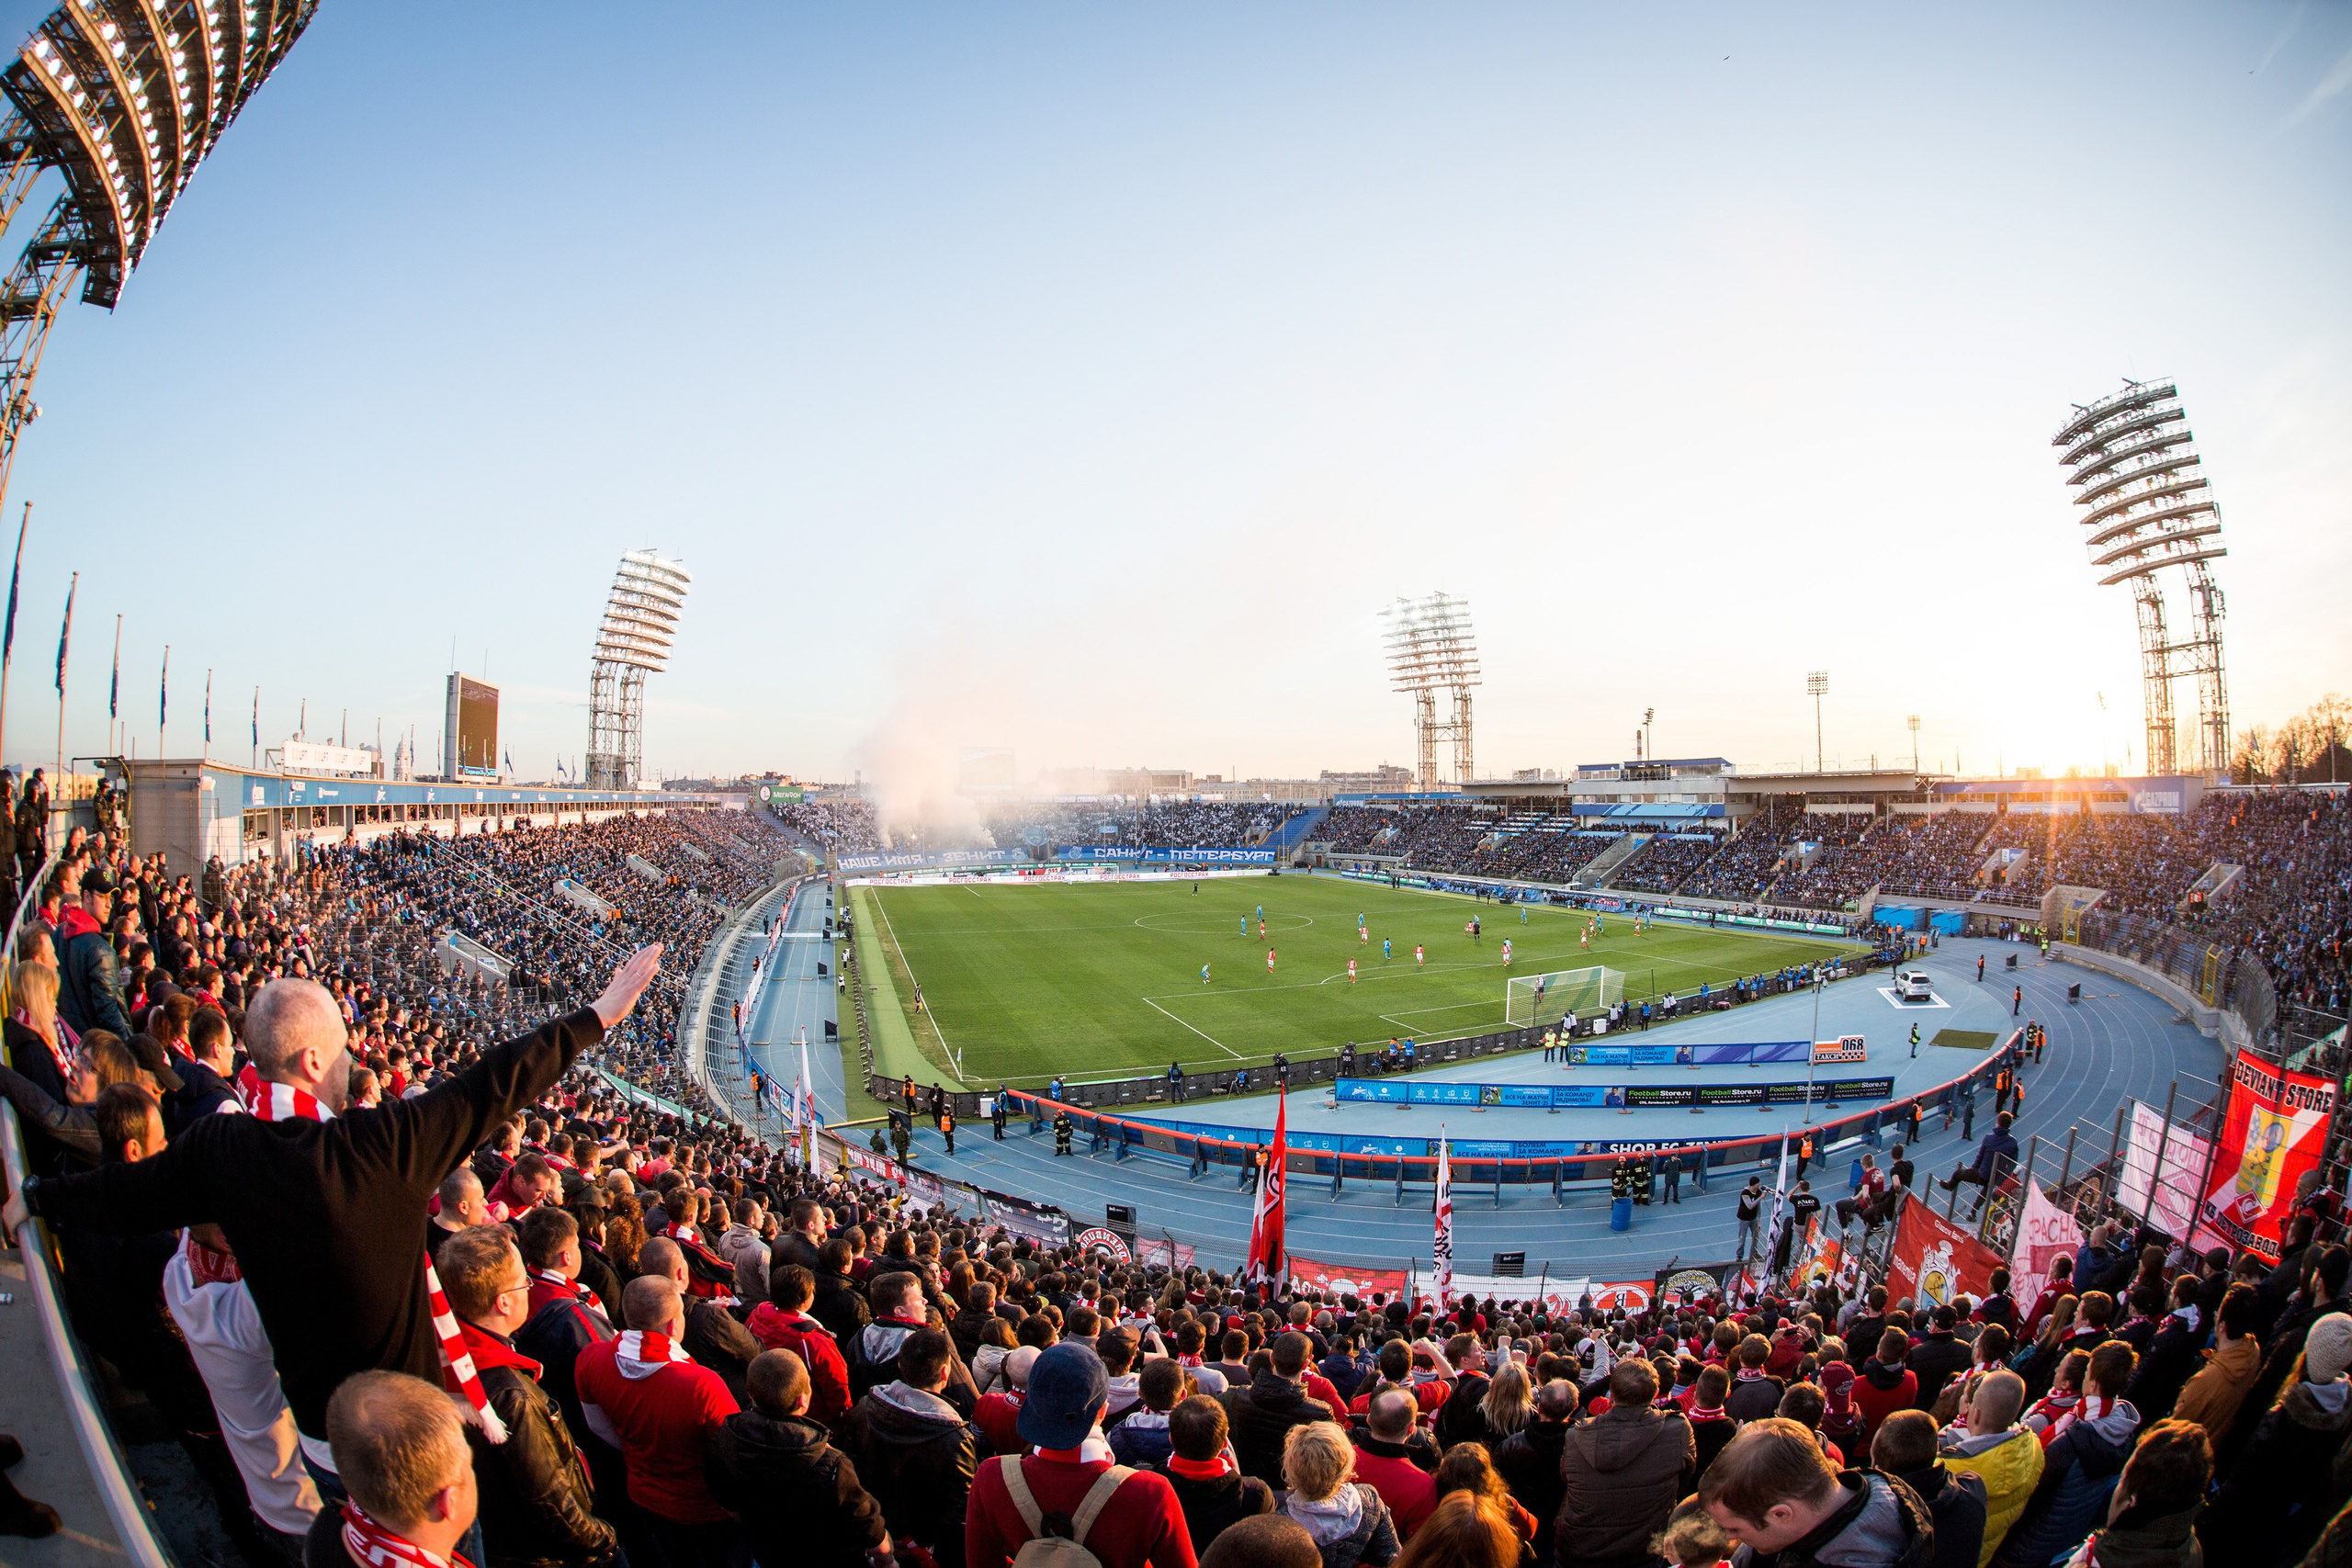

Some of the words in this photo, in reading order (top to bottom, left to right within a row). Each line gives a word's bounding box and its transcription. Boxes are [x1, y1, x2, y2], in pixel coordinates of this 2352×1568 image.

[838, 856, 882, 870] НАШЕ
[884, 853, 923, 866] ИМЯ
[942, 850, 1006, 862] ЗЕНИТ
[1093, 847, 1153, 859] САНКТ
[1170, 849, 1275, 862] ПЕТЕРБУРГ
[869, 877, 913, 886] РОСГОССТРАХ
[1841, 1038, 1864, 1051] 068
[2235, 1059, 2285, 1102] DEVIANT
[2285, 1082, 2334, 1114] STORE
[1610, 1143, 1657, 1154] SHOP
